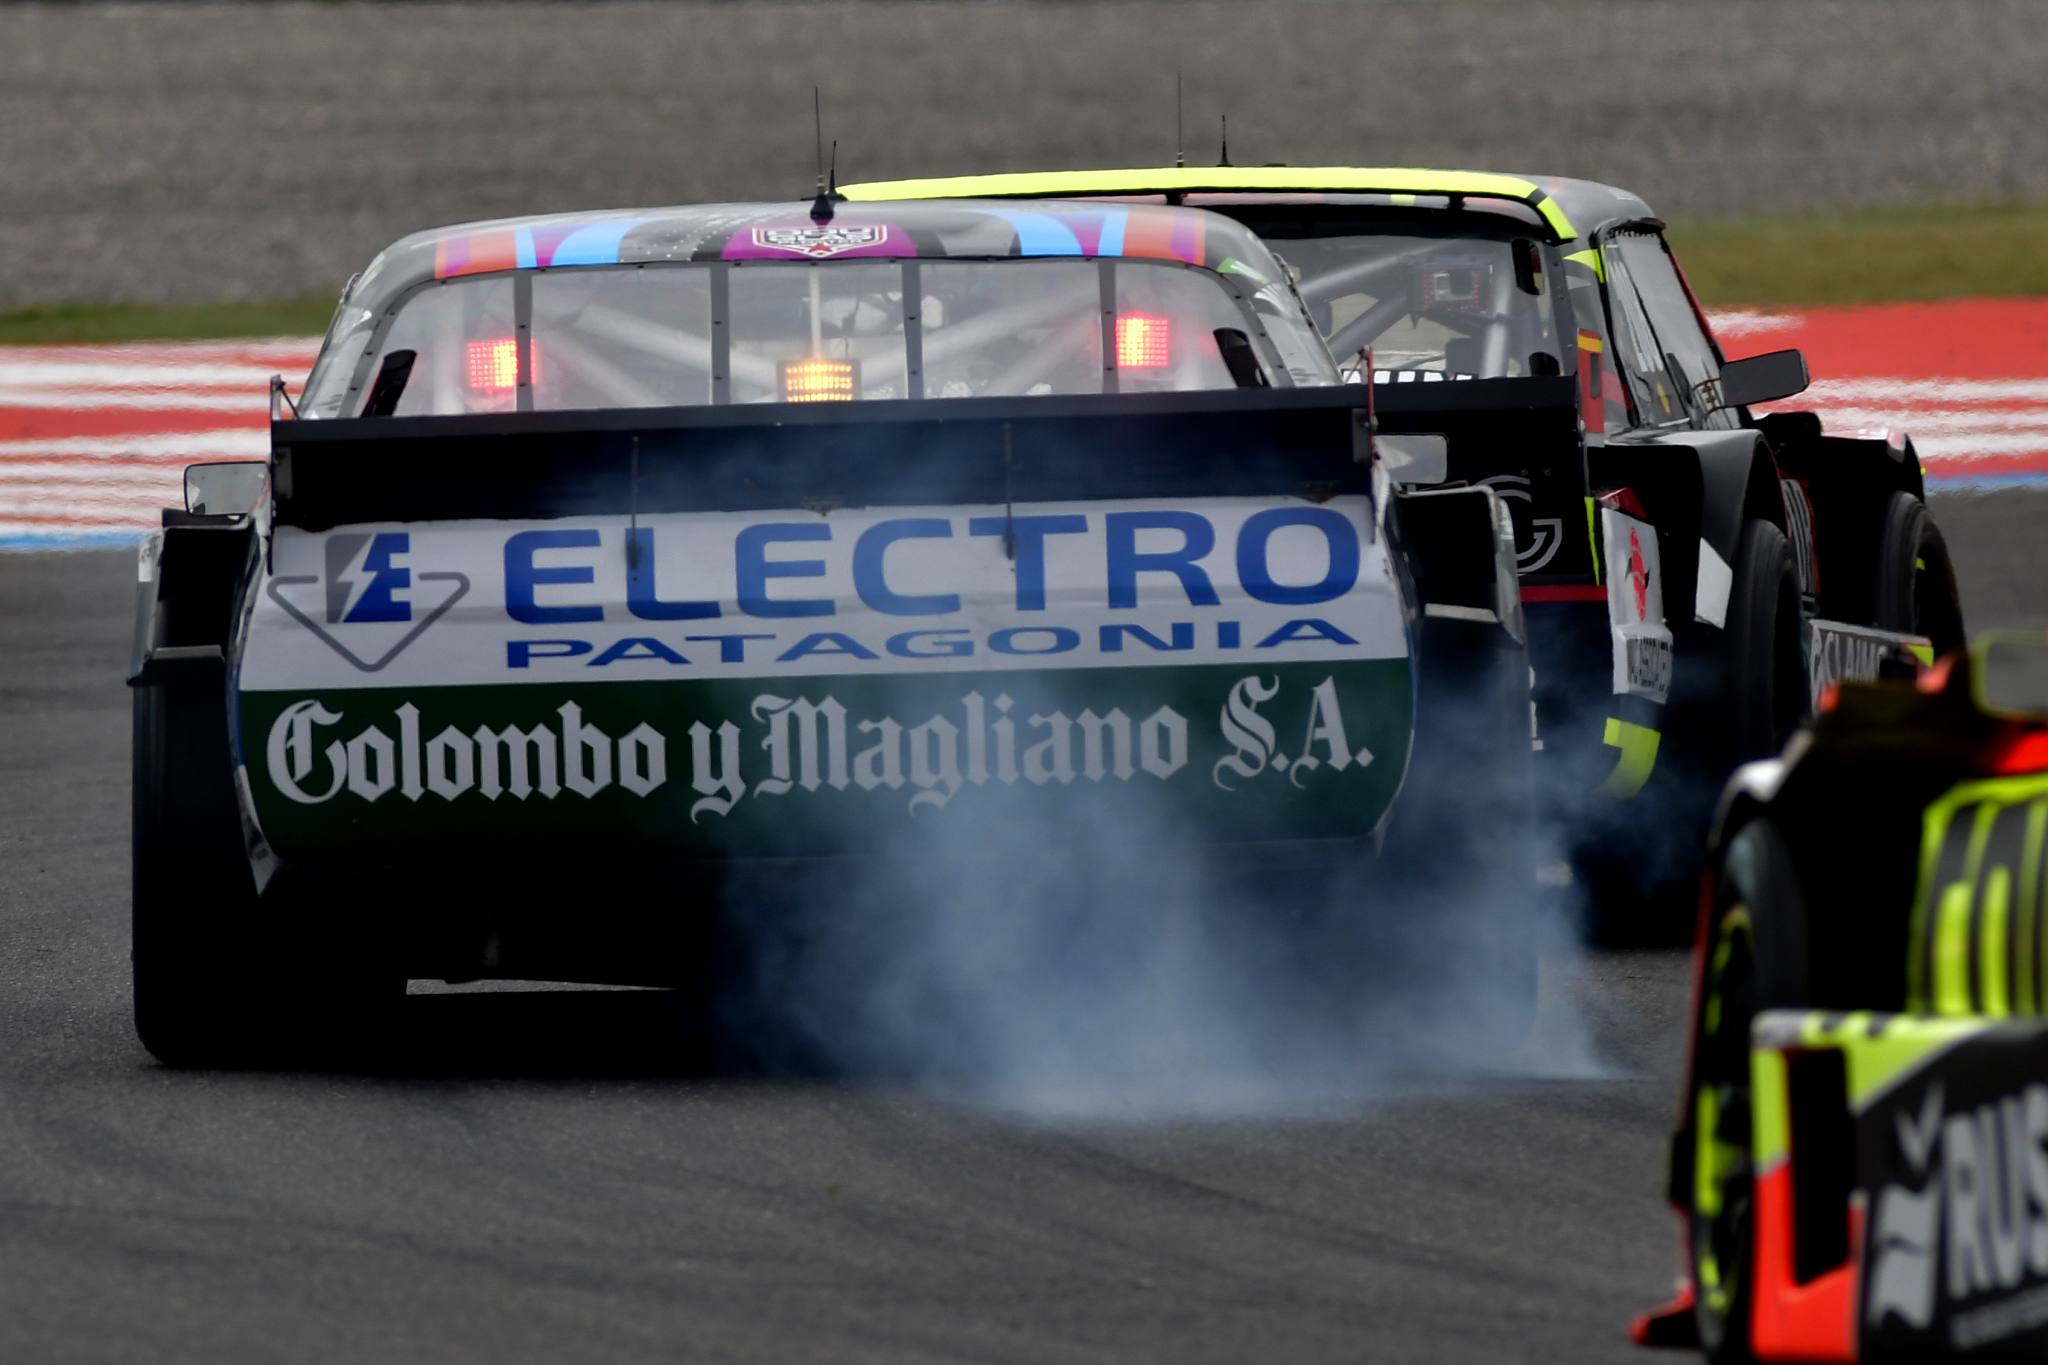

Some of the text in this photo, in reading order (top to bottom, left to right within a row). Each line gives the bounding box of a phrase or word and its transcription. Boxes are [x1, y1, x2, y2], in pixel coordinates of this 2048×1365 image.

[504, 507, 1361, 623] ELECTRO
[508, 619, 1361, 667] PATAGONIA
[266, 674, 1376, 824] Colombo y Magliano S.A.
